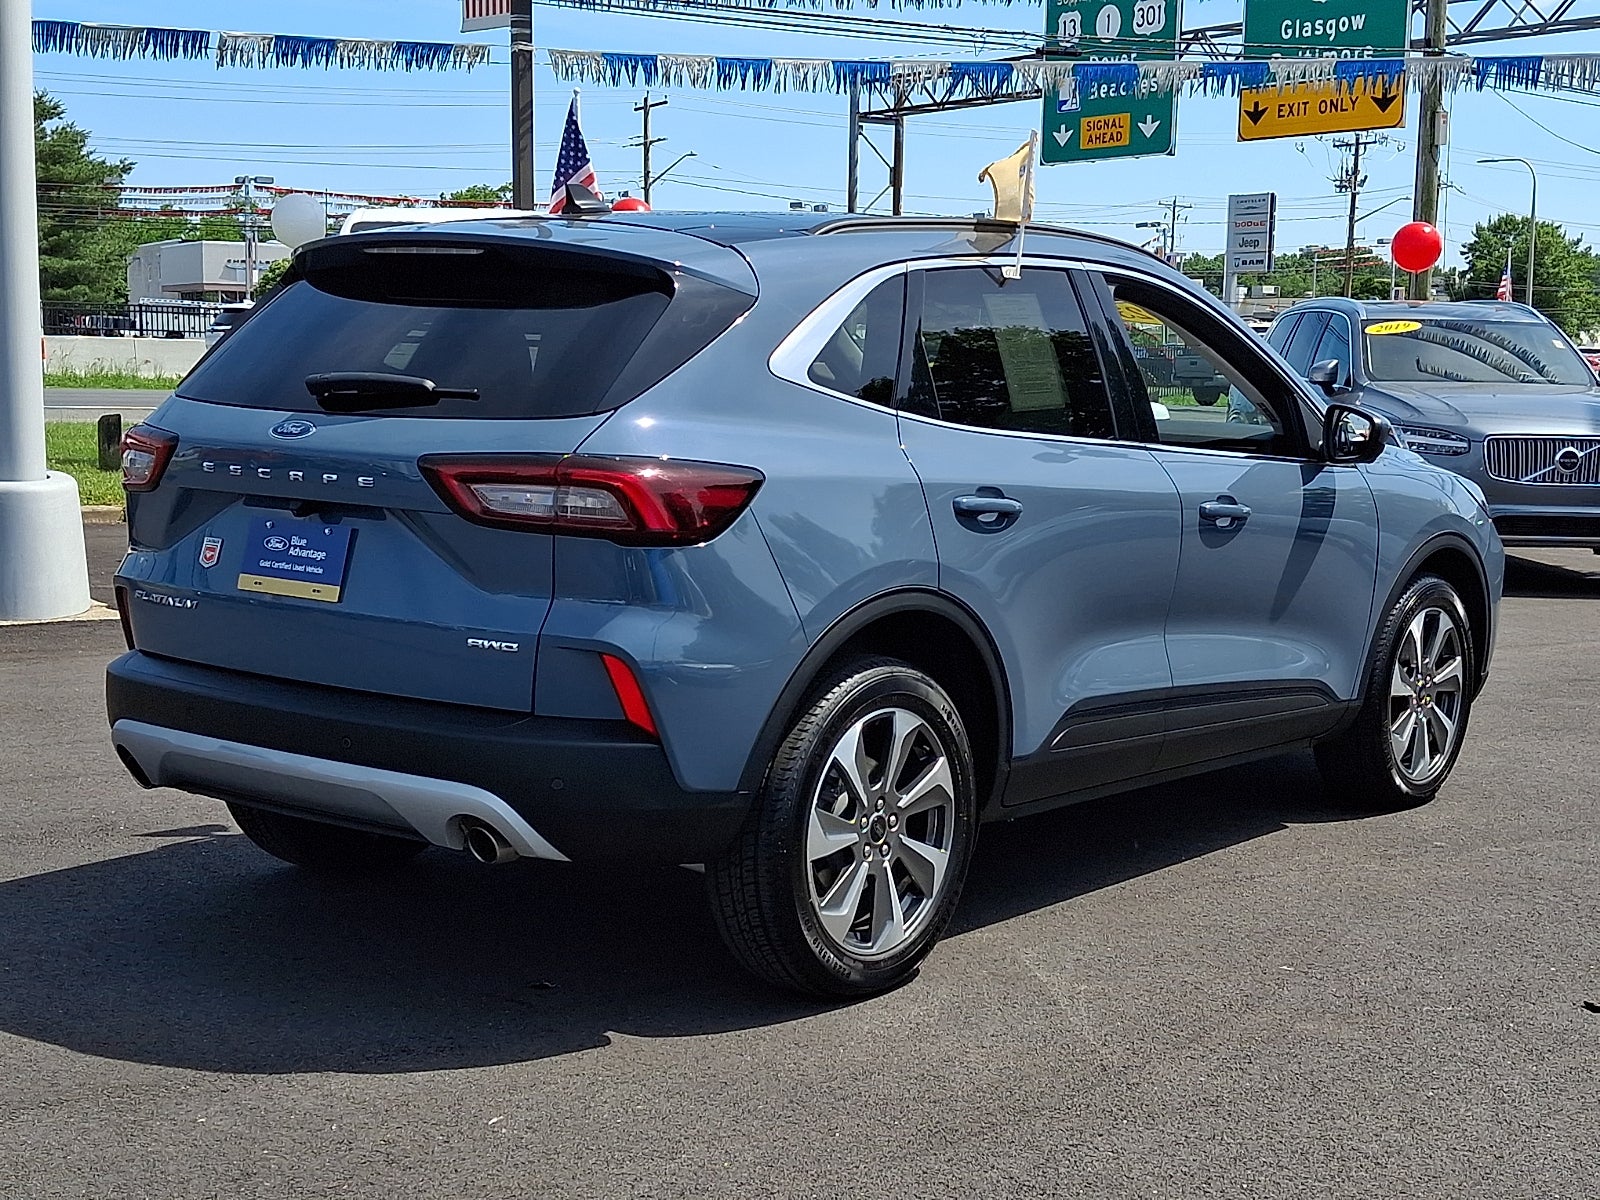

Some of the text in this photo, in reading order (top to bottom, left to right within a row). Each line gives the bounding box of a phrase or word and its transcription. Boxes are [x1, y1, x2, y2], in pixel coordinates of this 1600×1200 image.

[1106, 13, 1111, 34] 1
[1136, 4, 1162, 28] 301
[1063, 18, 1077, 37] 13
[1281, 14, 1366, 41] Glasgow
[1089, 77, 1158, 100] Beaces
[1277, 96, 1359, 119] EXIT ONLY
[1086, 117, 1124, 132] SIGNAL
[1086, 131, 1123, 145] AHEAD
[1238, 237, 1260, 250] Jeep
[1376, 323, 1411, 333] 2019
[202, 461, 374, 488] ESCAPE
[291, 535, 307, 546] Blue
[288, 546, 327, 560] Advantage
[259, 559, 324, 575] Gold Certified Used Vehicle
[135, 590, 199, 609] PLATINUM
[467, 638, 519, 652] AWD
